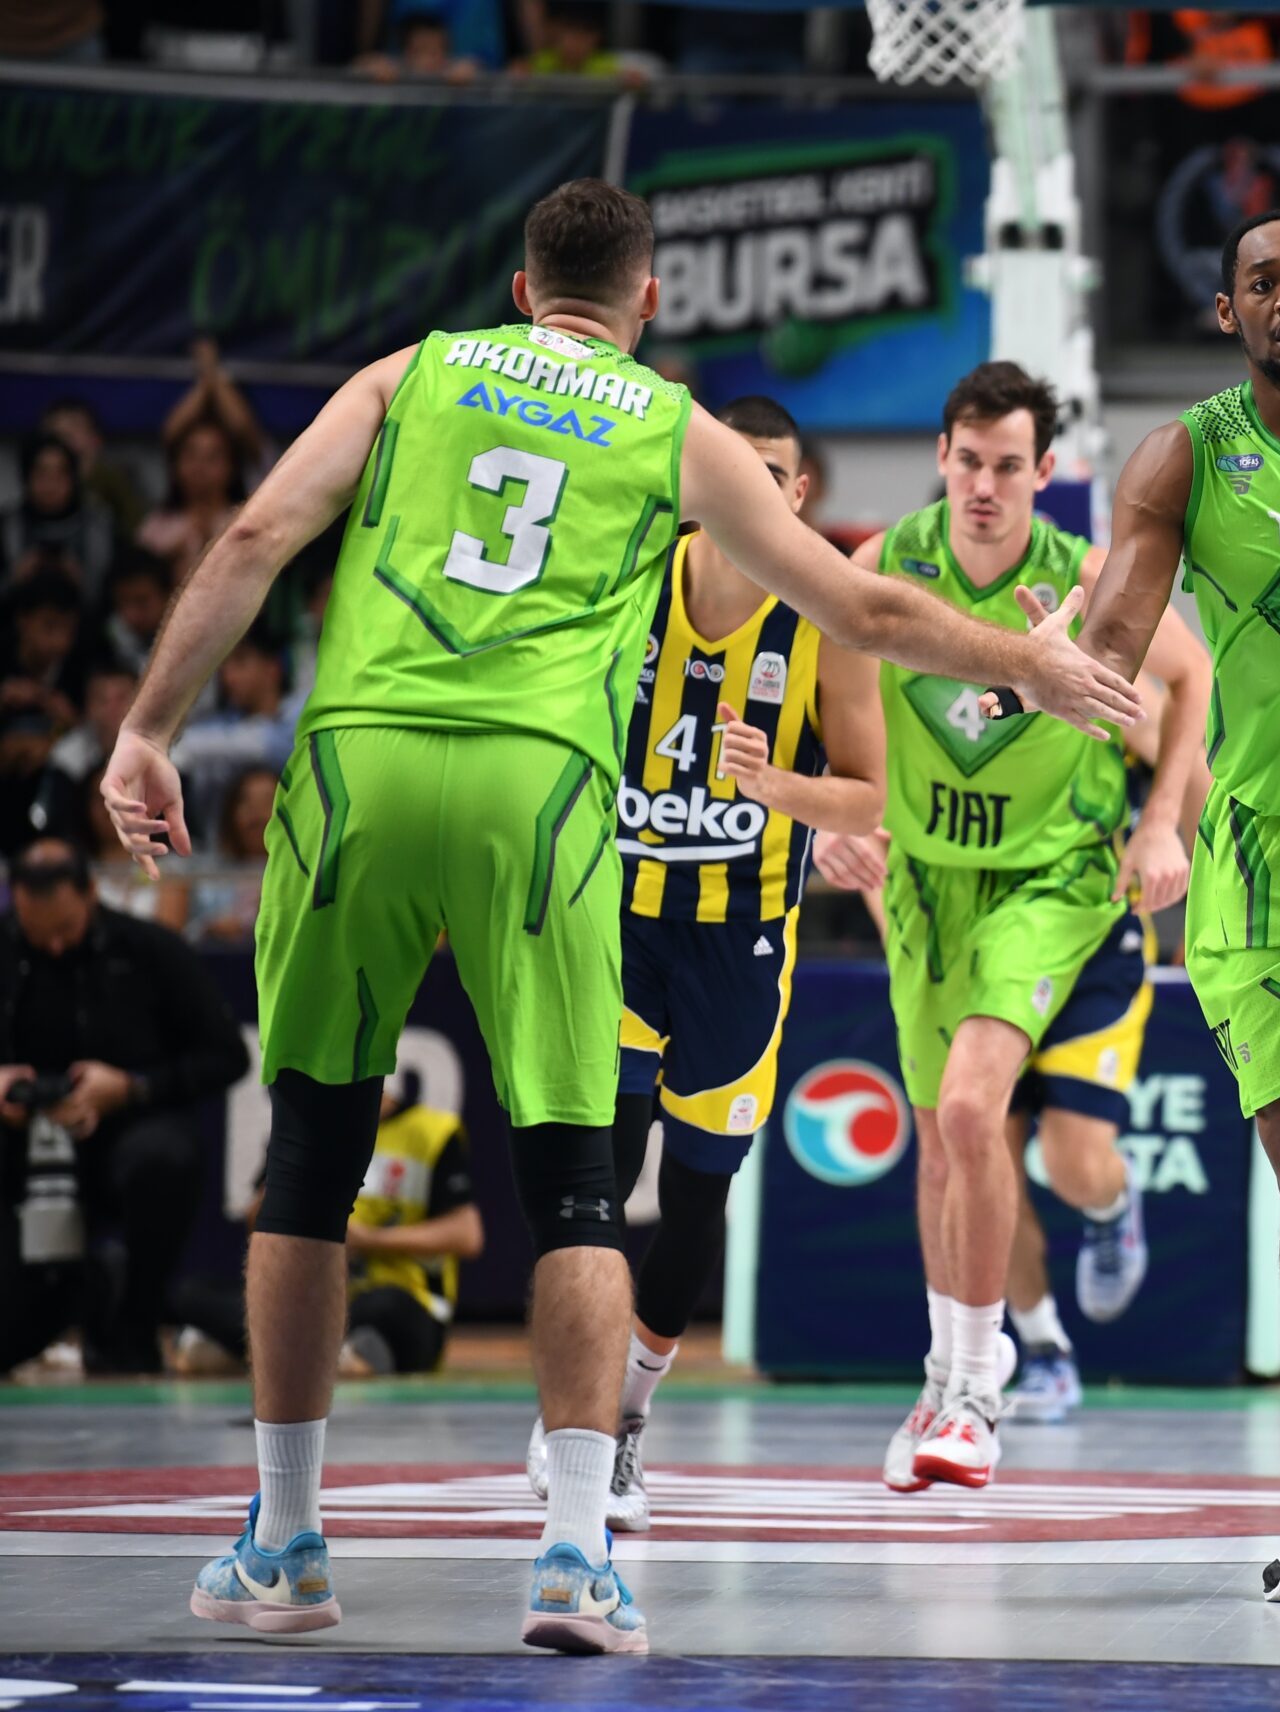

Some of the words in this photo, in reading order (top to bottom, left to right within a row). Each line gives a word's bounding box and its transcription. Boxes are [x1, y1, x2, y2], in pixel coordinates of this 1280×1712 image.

[653, 212, 929, 336] BURSA
[444, 340, 655, 421] AKDAMAR
[456, 381, 617, 448] AYGAZ
[442, 444, 569, 595] 3
[616, 774, 765, 842] beko
[925, 780, 1012, 849] FIAT
